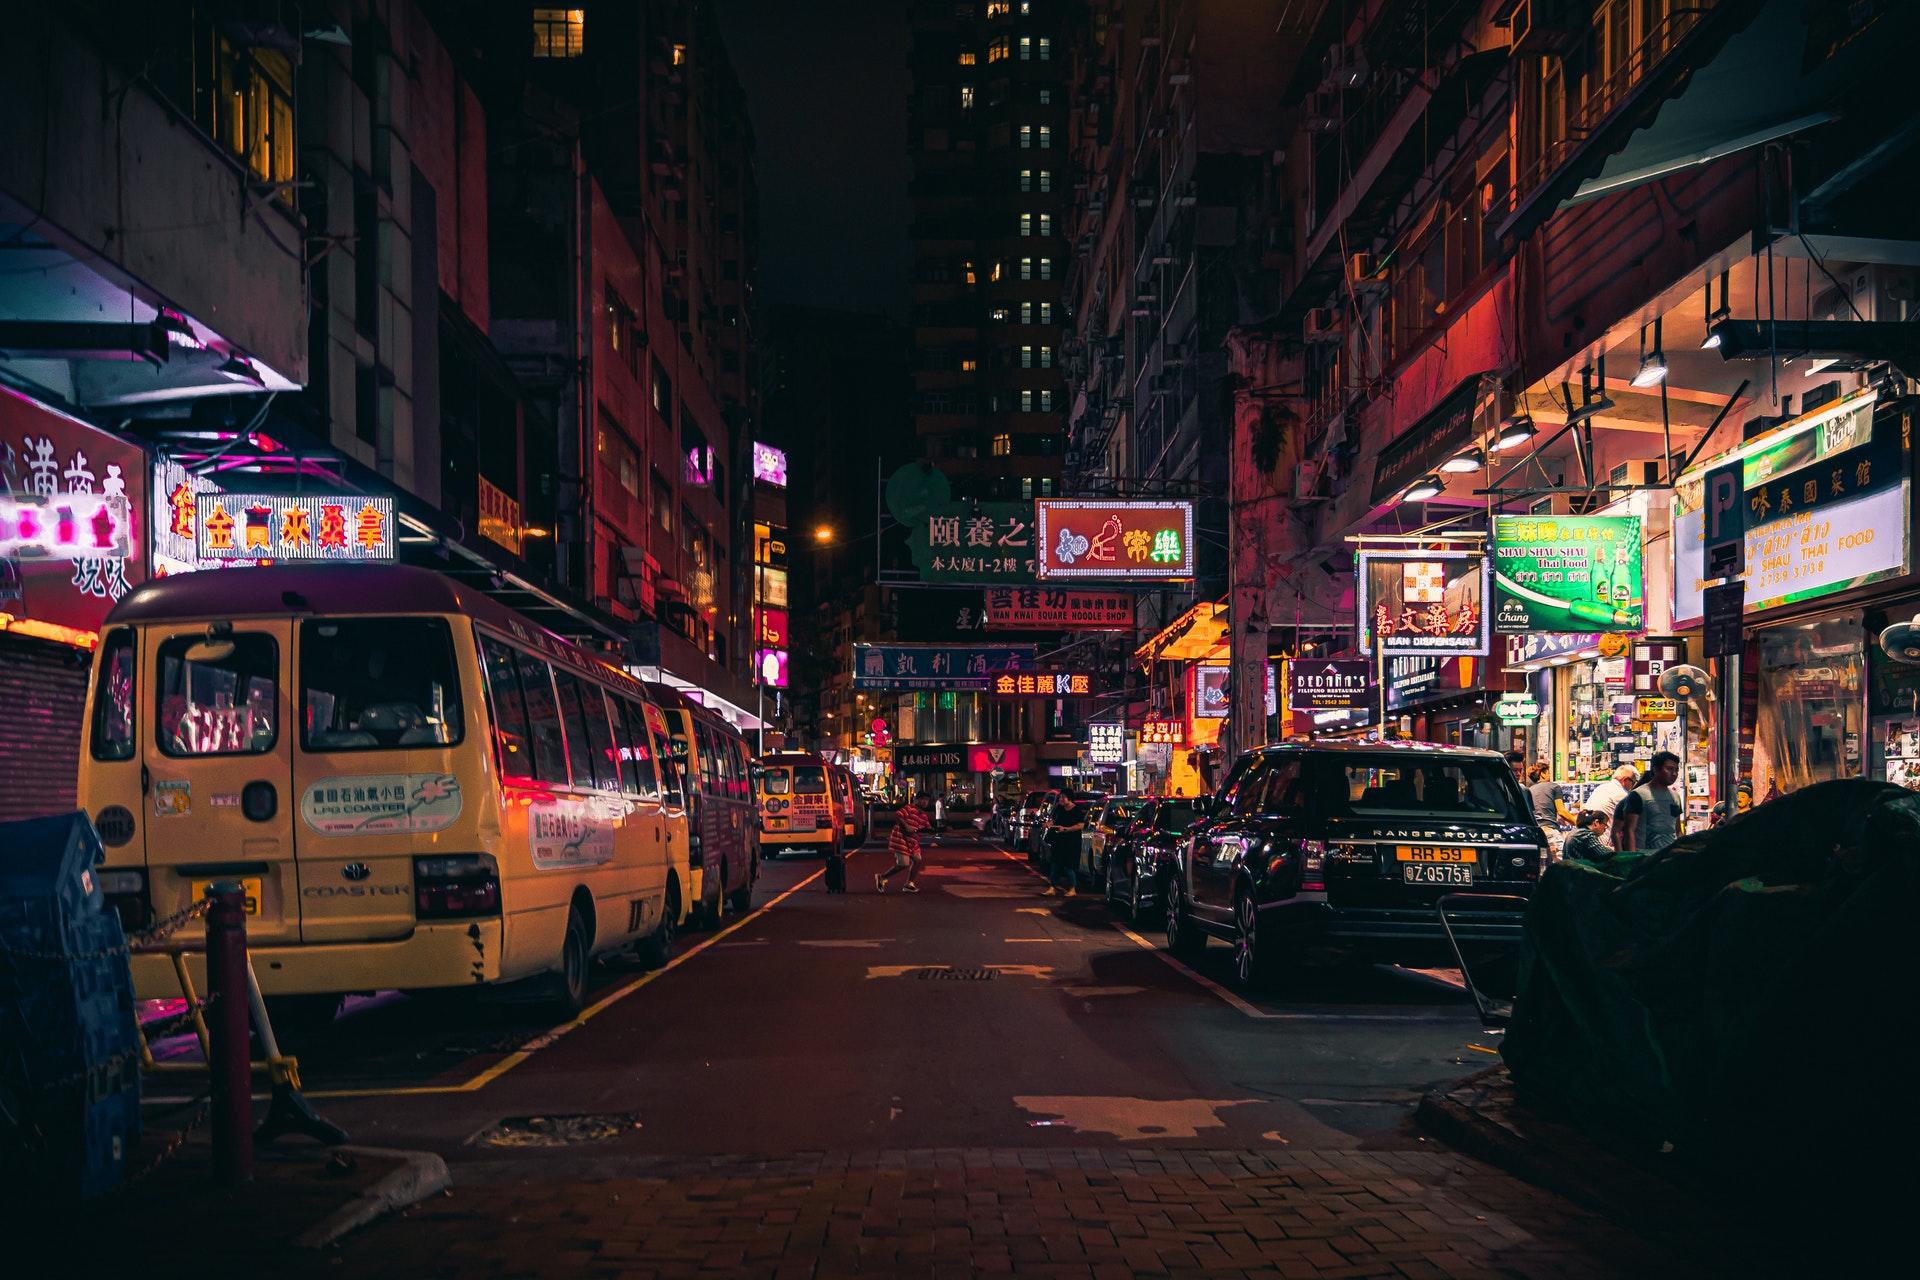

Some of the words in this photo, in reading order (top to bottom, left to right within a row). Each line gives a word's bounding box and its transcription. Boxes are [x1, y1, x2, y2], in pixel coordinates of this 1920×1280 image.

[1711, 473, 1737, 541] P
[928, 514, 1035, 548] 頤養之
[1498, 548, 1526, 558] SHAU
[1529, 548, 1556, 558] SHAU
[1560, 548, 1587, 557] SHAU
[1761, 552, 1792, 573] SHAU
[1800, 542, 1830, 561] THAI
[1838, 527, 1875, 551] FOOD
[1538, 558, 1560, 568] Thai
[1563, 558, 1588, 568] Food
[993, 611, 1010, 620] WAN
[1038, 611, 1067, 620] SQUARE
[1071, 611, 1101, 621] NOODLE
[1106, 612, 1126, 621] SHOP
[1498, 611, 1530, 624] Chang
[1387, 637, 1410, 646] MAN
[1413, 637, 1477, 647] DISPENSARY
[1649, 700, 1675, 708] 2019
[940, 752, 960, 766] DBS
[343, 803, 406, 815] COASTER
[1373, 830, 1436, 838] RANGE
[1444, 831, 1503, 840] ROVER
[1411, 847, 1435, 861] RR
[1440, 848, 1463, 861] 59
[303, 885, 410, 897] COASTER
